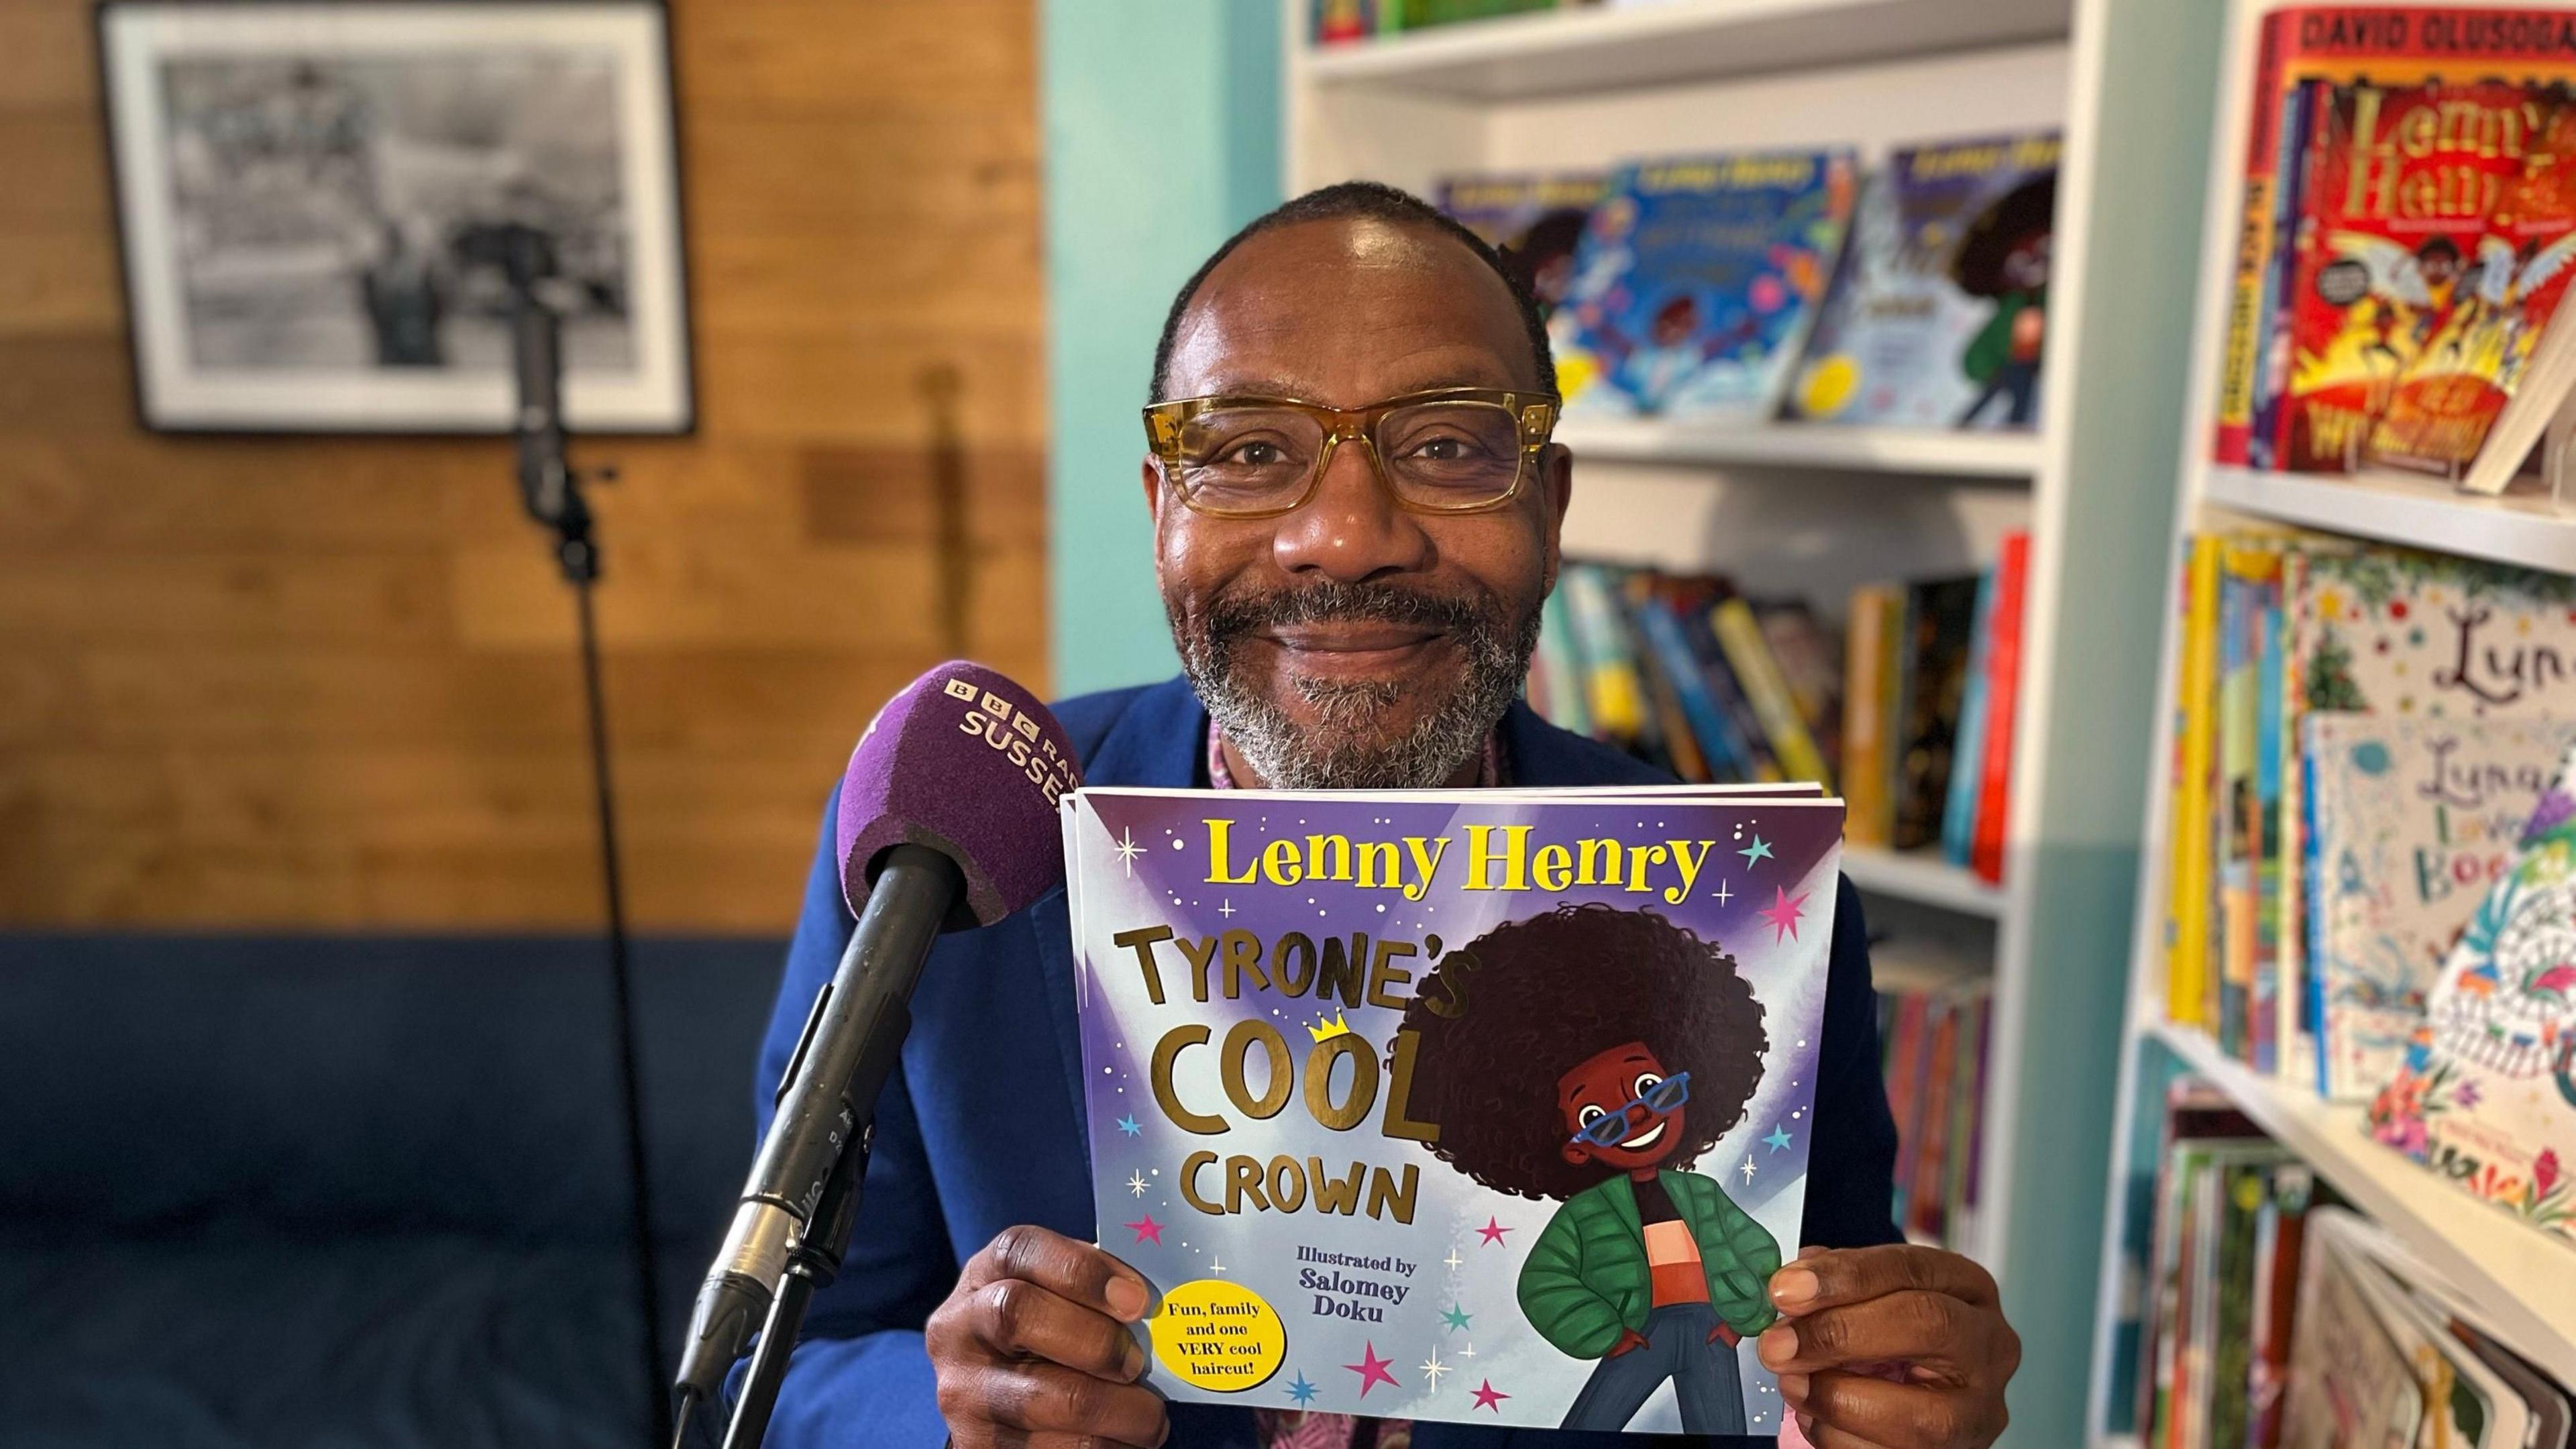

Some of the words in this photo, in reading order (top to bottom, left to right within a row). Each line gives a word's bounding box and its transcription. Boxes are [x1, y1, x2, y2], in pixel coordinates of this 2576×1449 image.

[2302, 15, 2407, 49] DAVID
[959, 711, 1064, 814] SUSSE
[1203, 819, 1451, 901] Lenny
[1461, 824, 1715, 904] Henry
[1114, 924, 1482, 1018] TYRONE'S
[1150, 1019, 1440, 1141] COOL
[1179, 1150, 1419, 1225] CROWN
[1297, 1245, 1391, 1272] Illustrated
[1395, 1258, 1417, 1278] by
[1299, 1268, 1410, 1305] Salomey
[1168, 1303, 1207, 1318] Fun,
[1210, 1302, 1260, 1318] family
[1312, 1295, 1383, 1323] Doku
[1186, 1323, 1216, 1336] and
[1219, 1325, 1248, 1336] one
[1177, 1343, 1224, 1356] VERY
[1229, 1343, 1263, 1356] cool
[1191, 1361, 1254, 1376] haircut!
